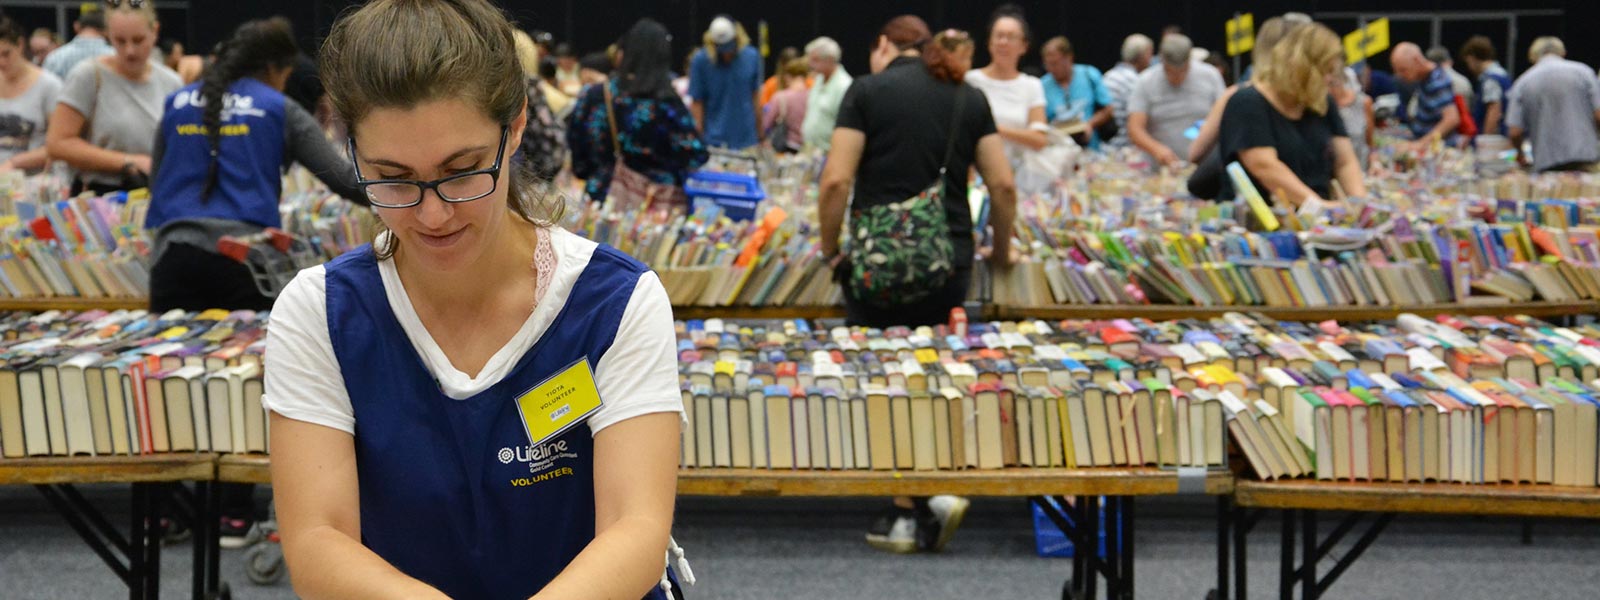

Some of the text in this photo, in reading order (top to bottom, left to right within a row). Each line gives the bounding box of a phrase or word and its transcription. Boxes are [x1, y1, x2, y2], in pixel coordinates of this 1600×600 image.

[540, 387, 576, 410] VOLUNTEER
[546, 385, 565, 397] YIOTA
[516, 440, 568, 462] Lifeline
[510, 467, 574, 487] VOLUNTEER
[530, 462, 554, 473] Gold Coast
